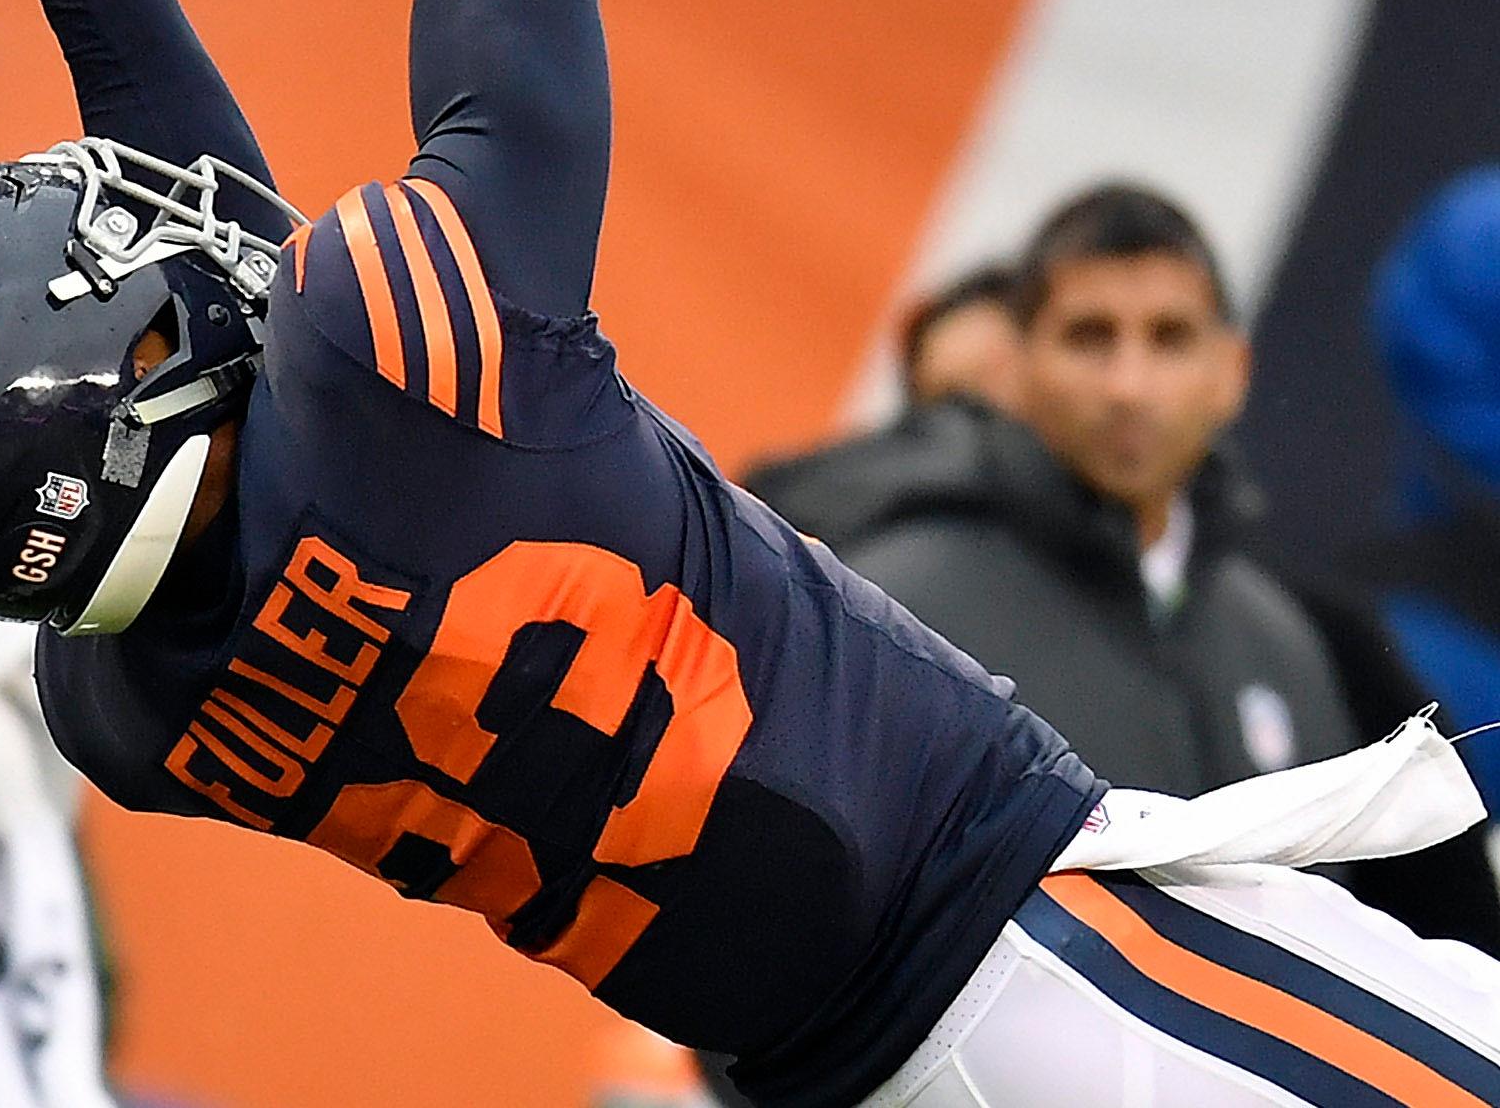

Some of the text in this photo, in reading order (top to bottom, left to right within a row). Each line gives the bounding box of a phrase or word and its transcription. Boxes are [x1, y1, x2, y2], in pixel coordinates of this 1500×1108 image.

[57, 484, 80, 512] NFL
[12, 529, 67, 583] GSH
[164, 535, 412, 830] FULLER
